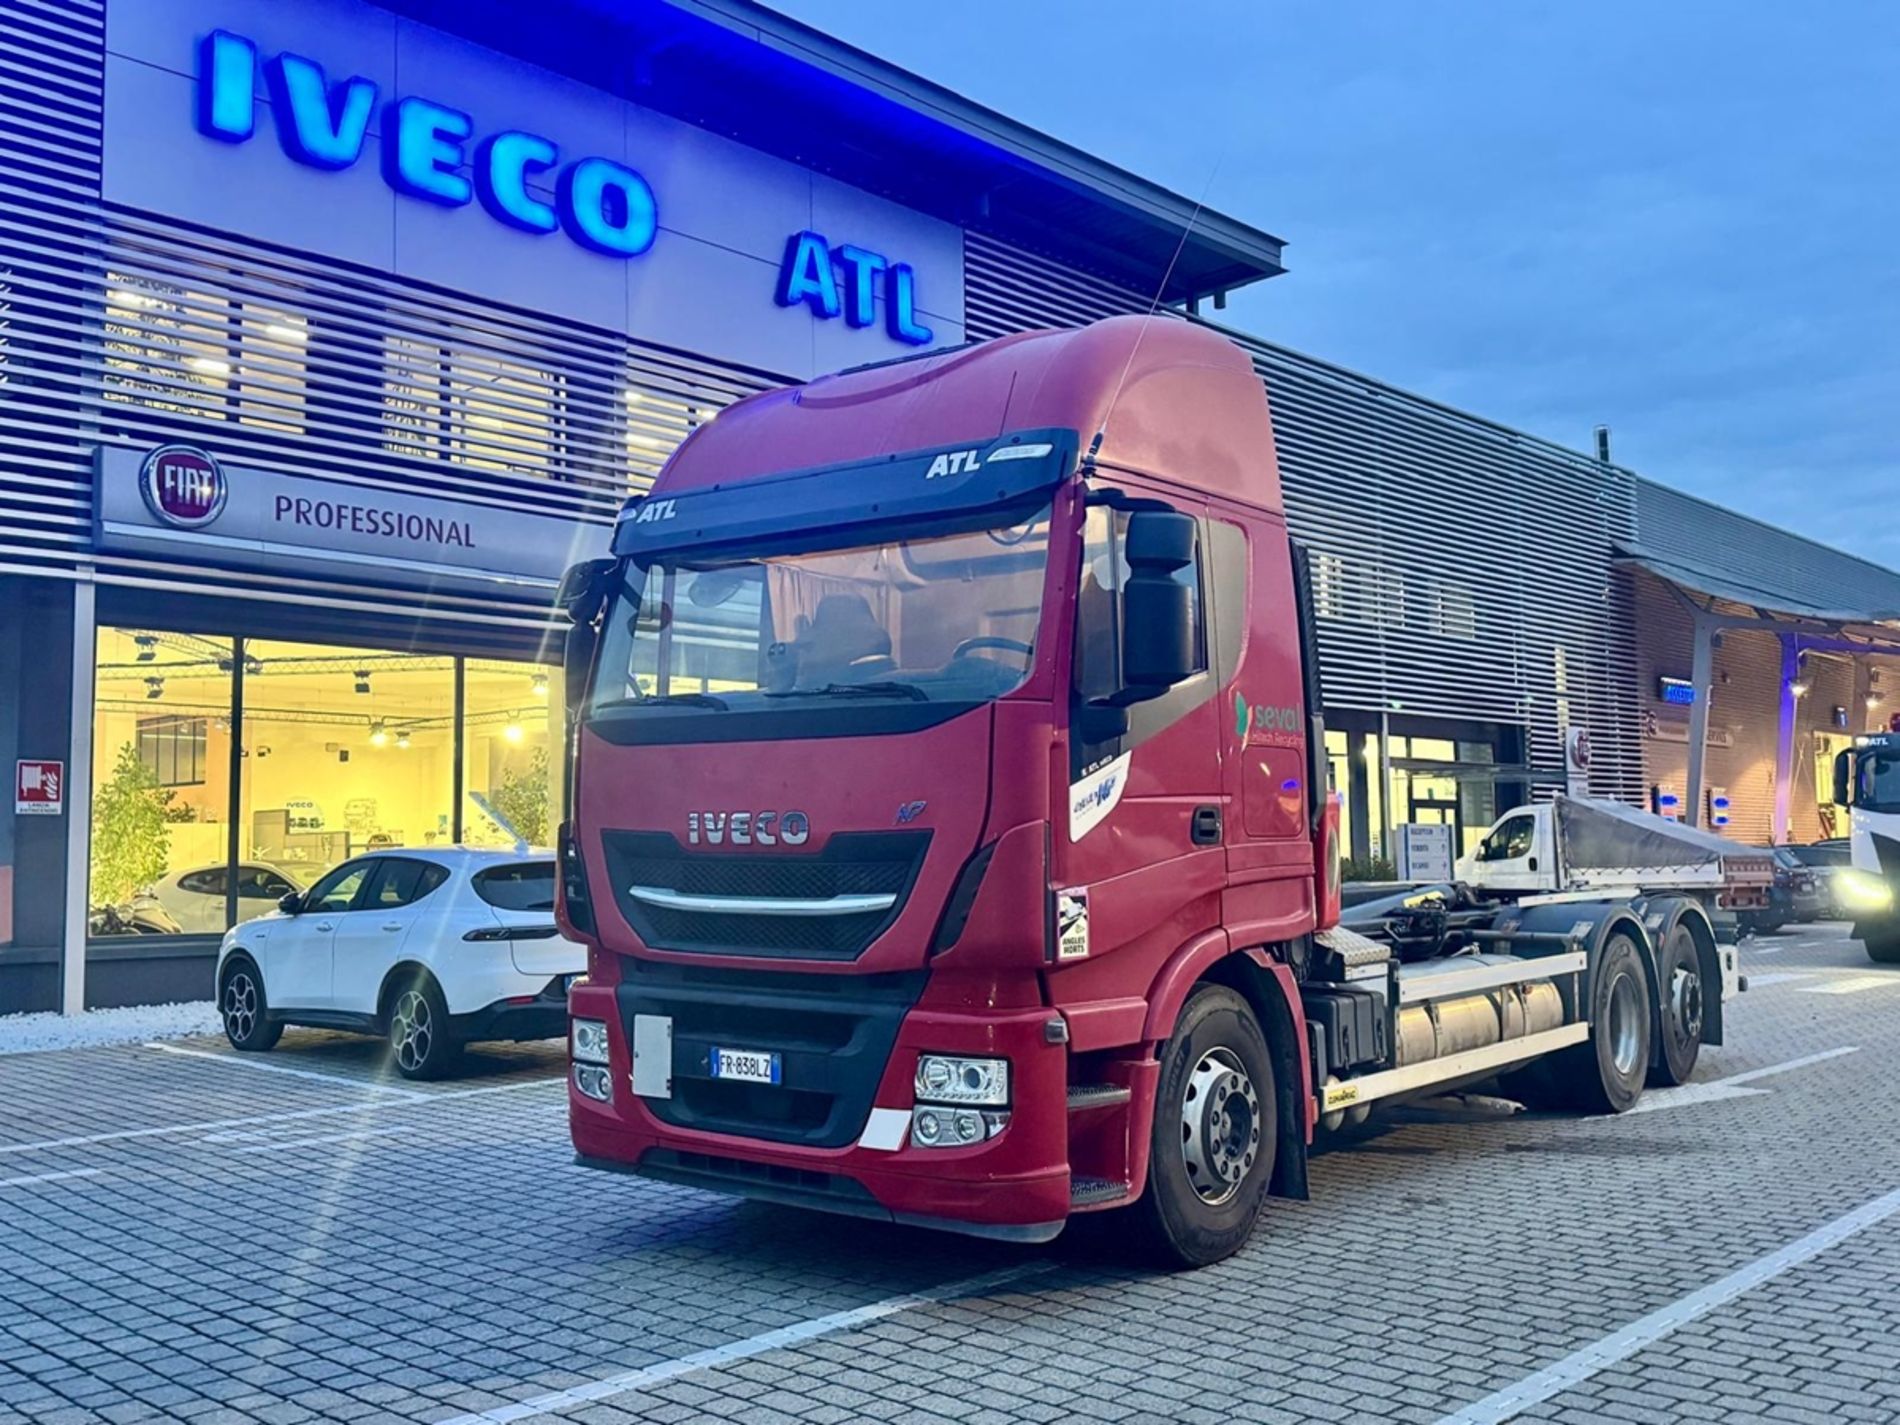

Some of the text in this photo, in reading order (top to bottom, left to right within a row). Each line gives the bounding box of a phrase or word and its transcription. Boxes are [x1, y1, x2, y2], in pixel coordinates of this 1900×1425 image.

[197, 29, 658, 258] IVECO
[775, 230, 934, 346] ATL
[926, 450, 980, 479] ATL
[164, 464, 213, 507] FIAT
[275, 495, 475, 548] PROFESSIONAL
[636, 499, 676, 523] ATL
[688, 811, 809, 845] IVECO
[1062, 936, 1085, 945] ANGLES
